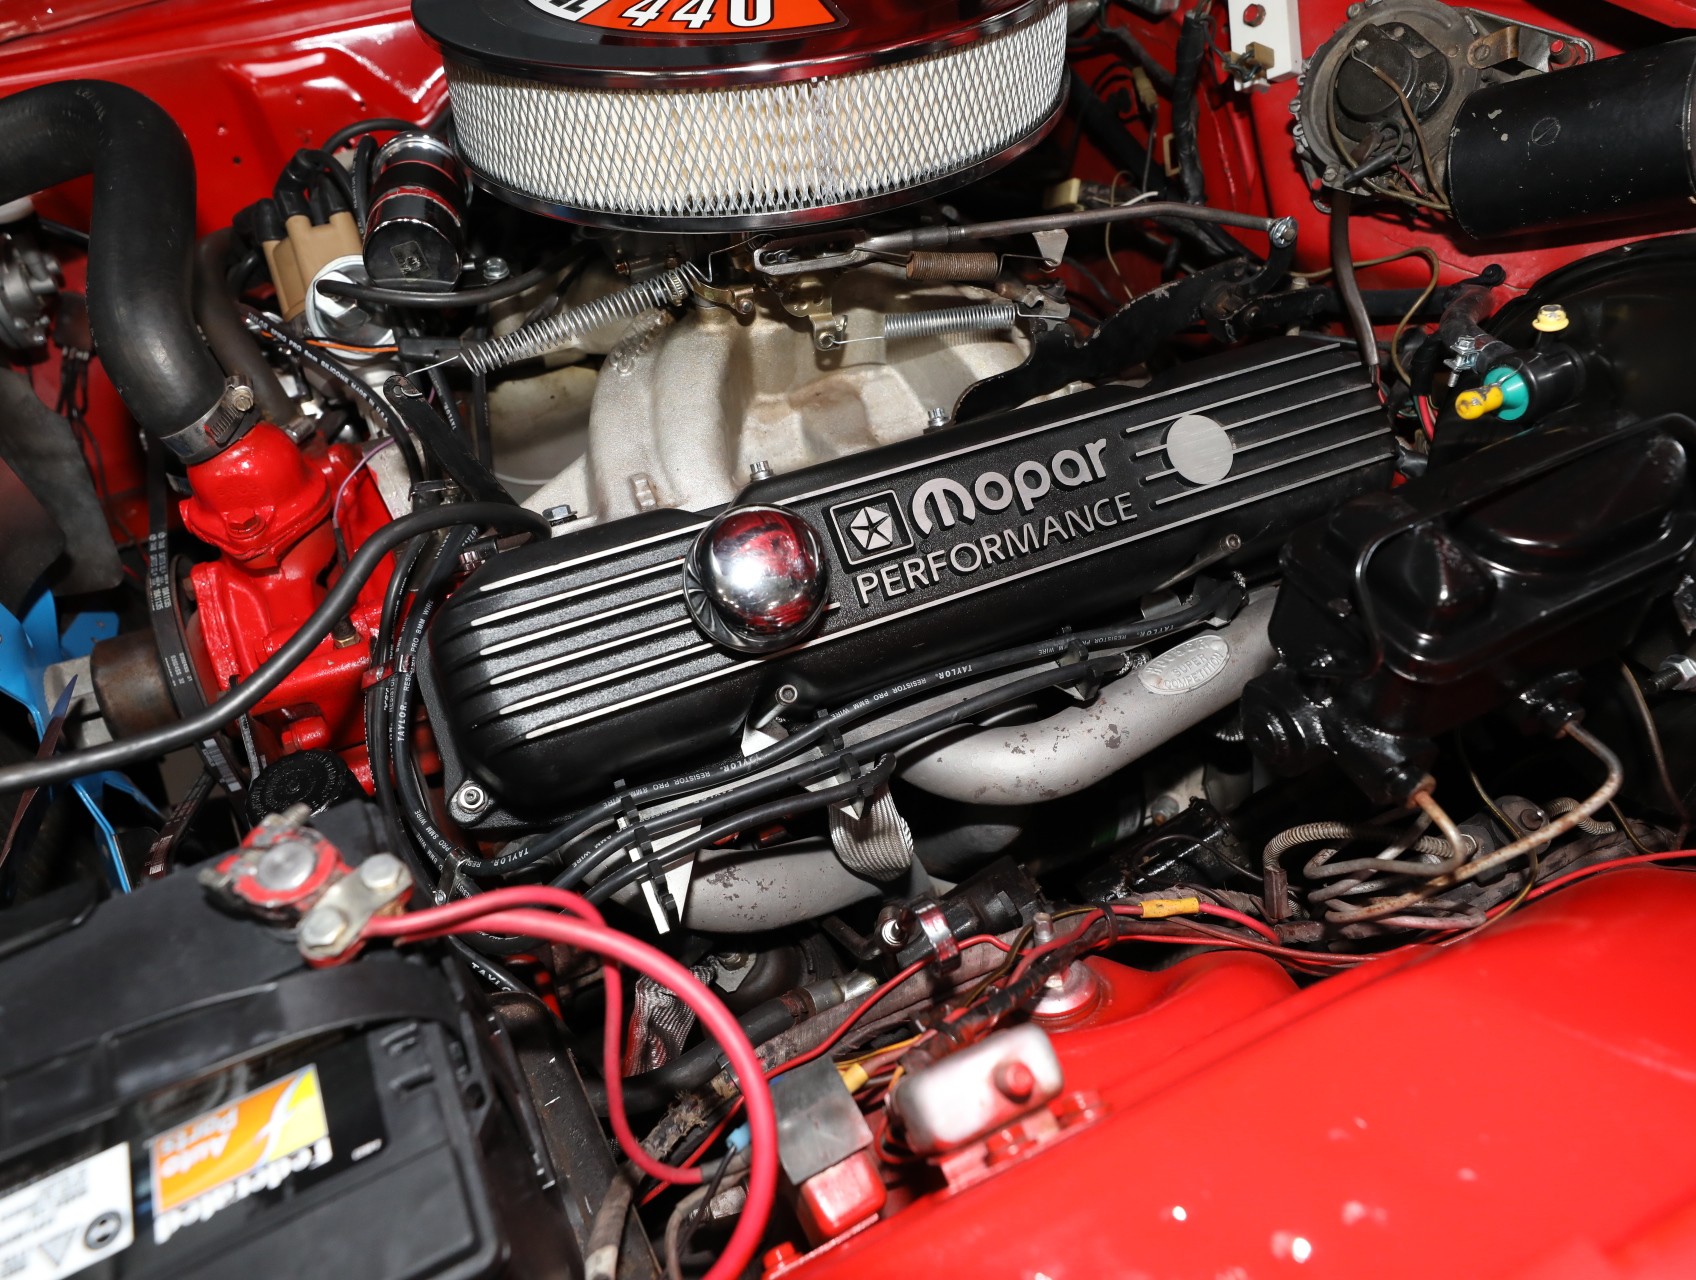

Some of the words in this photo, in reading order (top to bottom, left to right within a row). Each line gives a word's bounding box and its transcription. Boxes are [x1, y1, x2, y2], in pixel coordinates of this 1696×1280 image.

[620, 0, 774, 29] 440
[288, 339, 302, 352] PRO
[320, 360, 349, 384] SILICONE
[350, 382, 368, 400] MADE
[911, 438, 1107, 536] Mopar
[856, 491, 1138, 607] PERFORMANCE
[1140, 624, 1174, 637] TAYLOR
[1094, 634, 1127, 645] RESISTOR
[1038, 647, 1055, 656] WIRE
[397, 702, 408, 742] TAYLOR
[410, 637, 420, 653] PRO
[415, 619, 426, 634] 8MM
[422, 599, 434, 616] WIRE
[938, 664, 973, 680] TAYLOR
[1163, 652, 1224, 689] COMPETITION
[1172, 653, 1208, 677] SUPER
[892, 677, 927, 694] RESISTOR
[852, 698, 870, 711] 8MM
[873, 691, 889, 701] PRO
[831, 708, 850, 719] WIRE
[652, 781, 670, 791] PRO
[674, 770, 711, 786] RESISTOR
[630, 786, 648, 797] 8MM
[414, 809, 427, 826] WIRE
[416, 832, 427, 849] WIRE
[425, 825, 439, 840] 8MM
[438, 839, 452, 852] PRO
[493, 847, 529, 867] TAYLOR
[572, 851, 592, 868] WIRE
[161, 1106, 239, 1154] Parts
[160, 1132, 231, 1178] Auto
[153, 1136, 333, 1244] Federated
